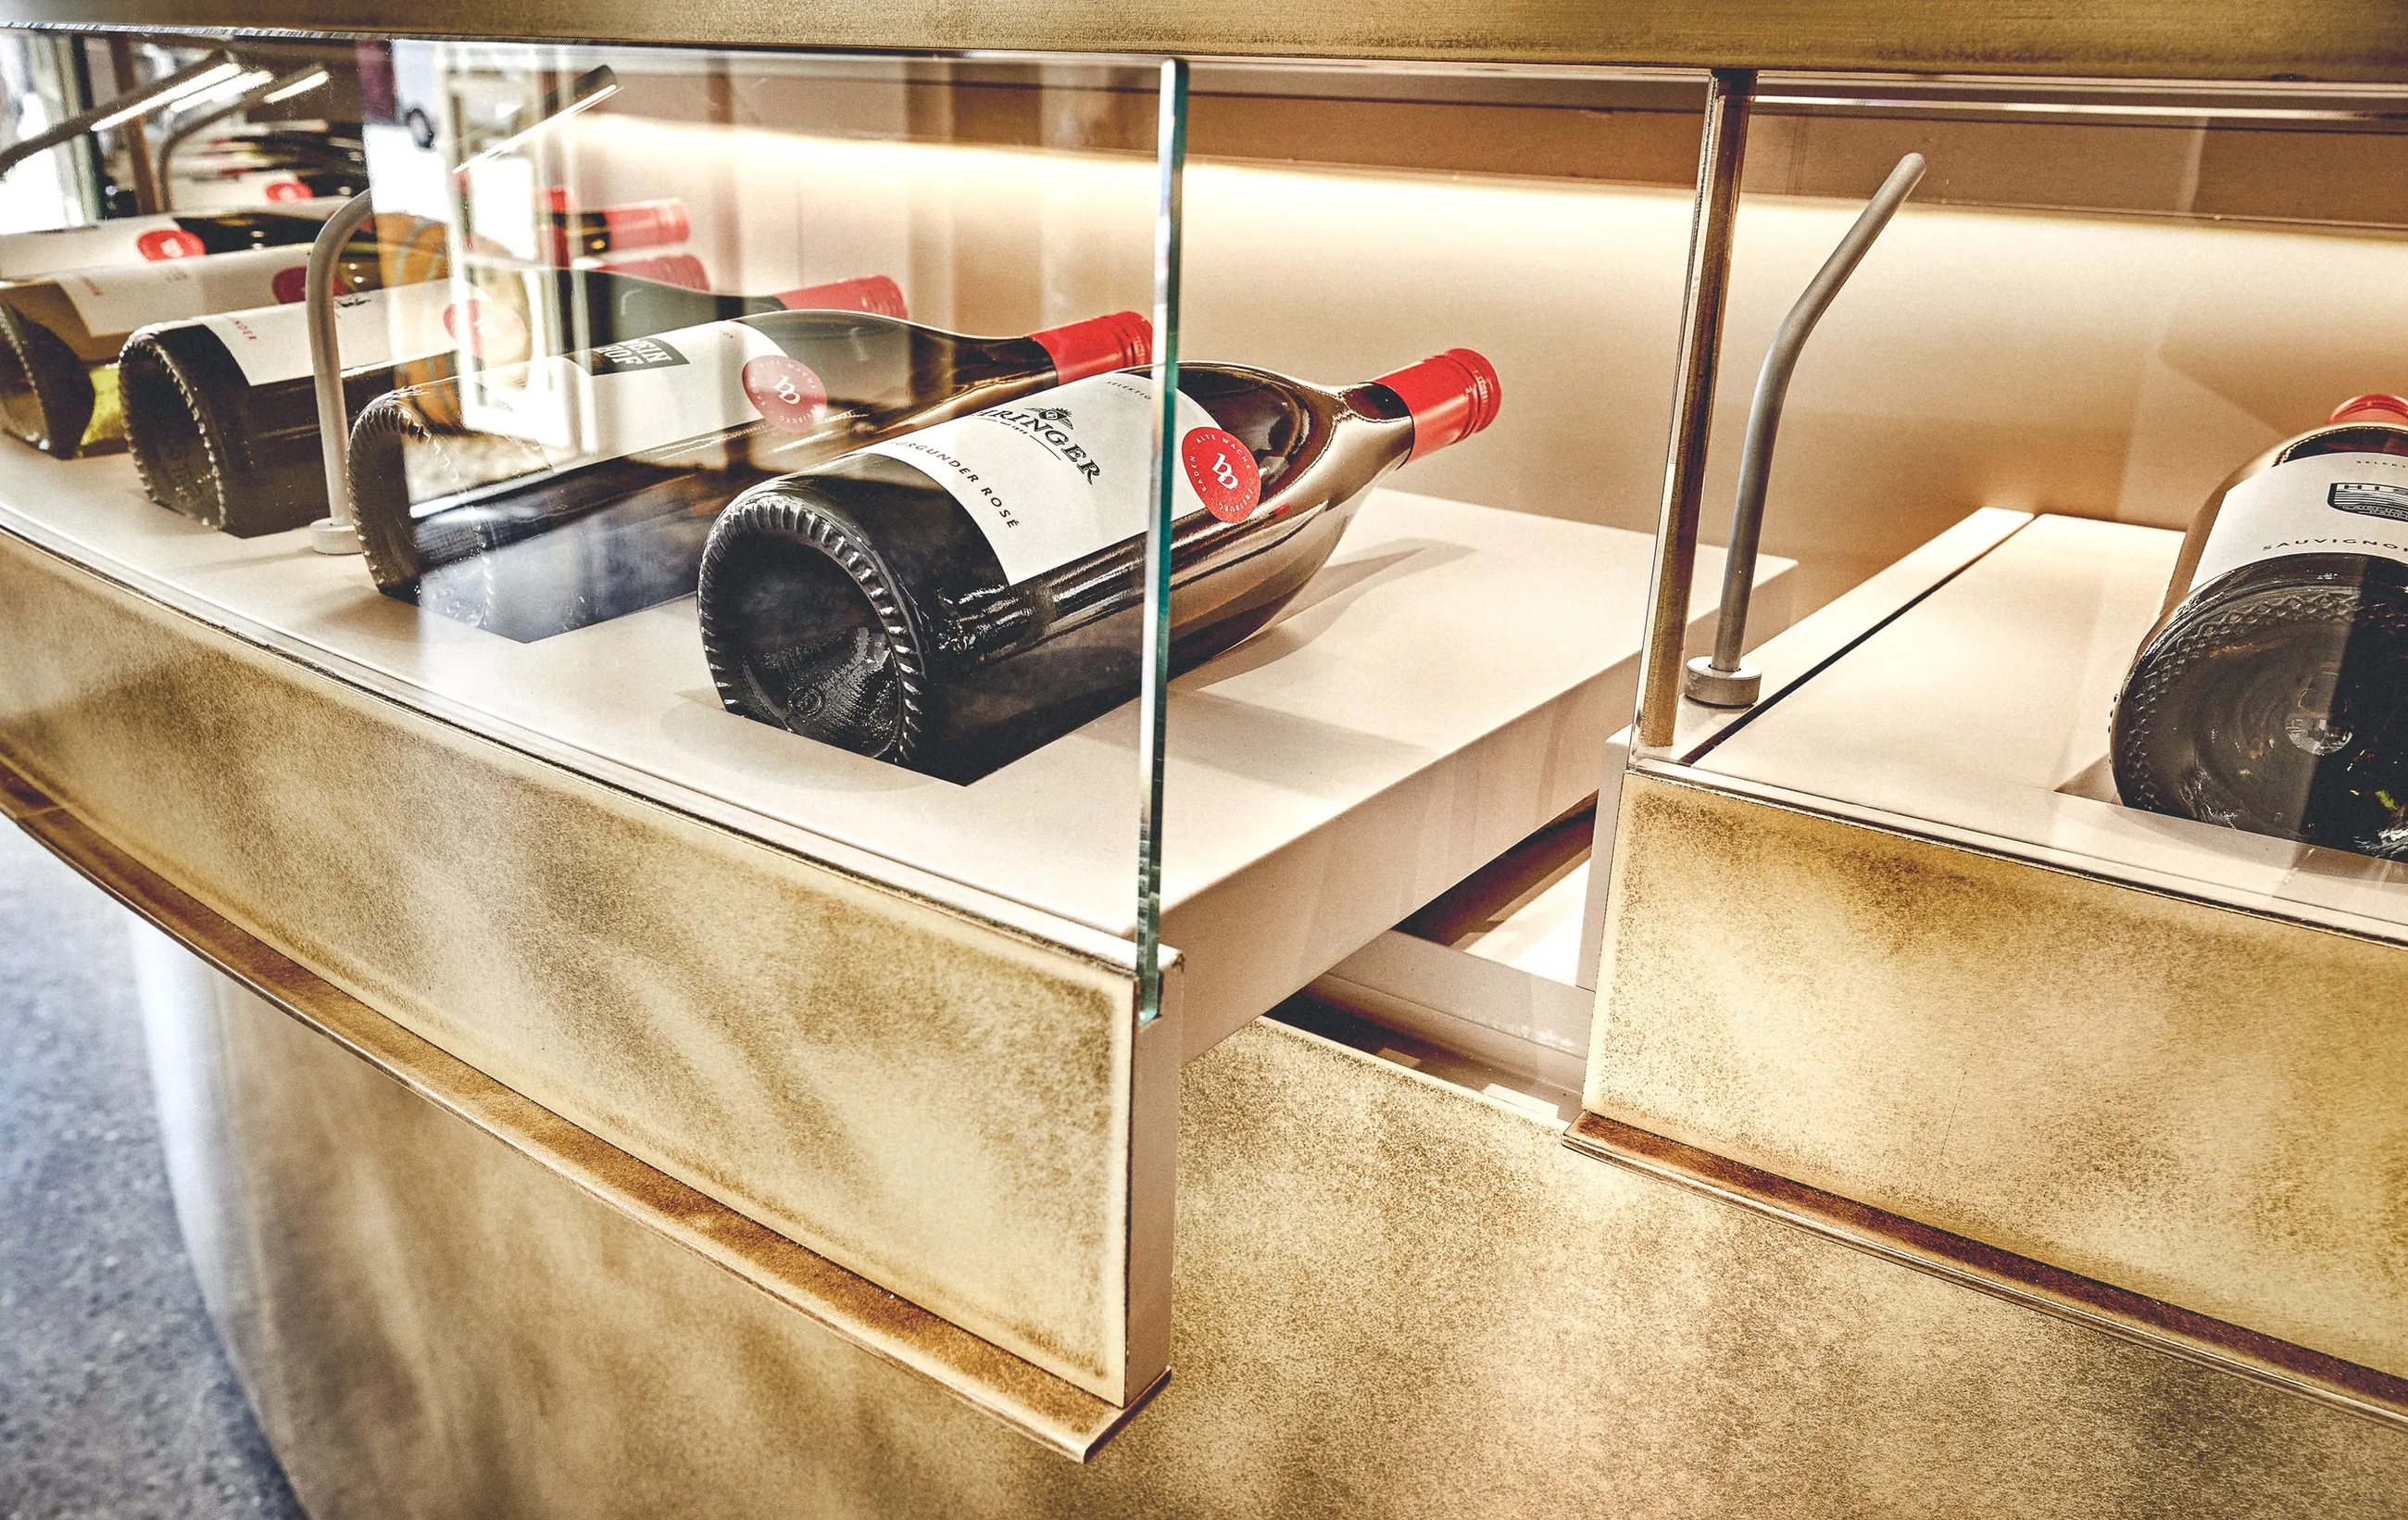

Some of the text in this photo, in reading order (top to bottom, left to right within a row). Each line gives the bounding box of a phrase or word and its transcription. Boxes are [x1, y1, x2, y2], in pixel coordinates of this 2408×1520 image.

[1106, 381, 1152, 400] SELEKTIO
[1196, 433, 1252, 470] ALTE WACHE
[890, 441, 1020, 529] URGUNDER ROSÉ
[1189, 455, 1208, 493] BADEN
[1218, 487, 1254, 513] FREIBURG
[2263, 538, 2408, 553] SAUVIGNO
